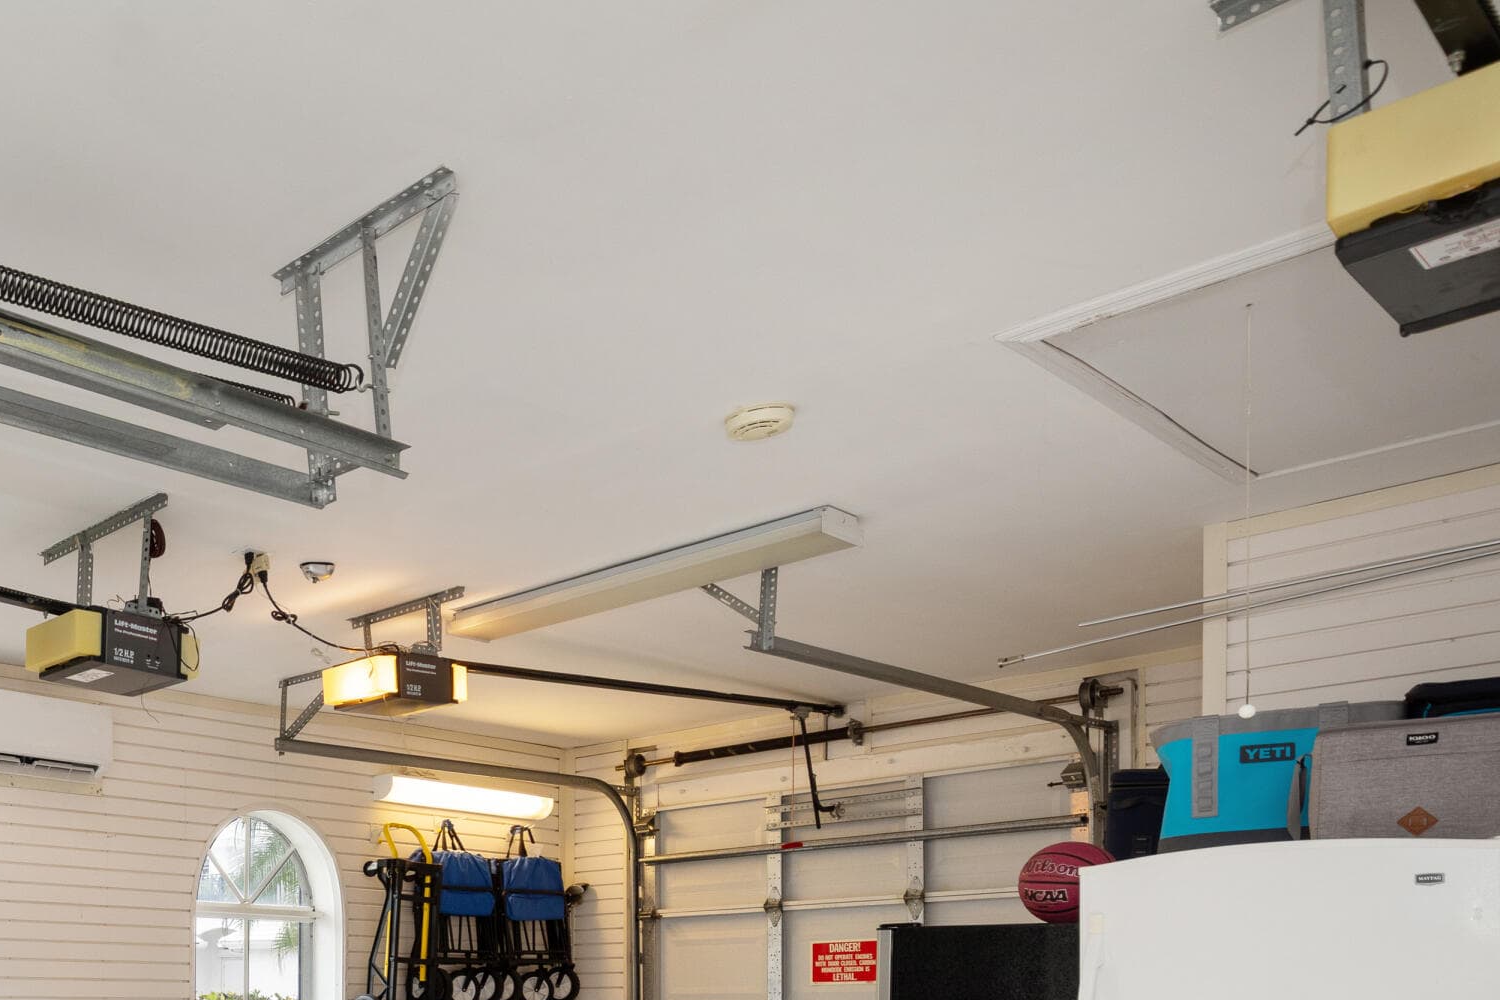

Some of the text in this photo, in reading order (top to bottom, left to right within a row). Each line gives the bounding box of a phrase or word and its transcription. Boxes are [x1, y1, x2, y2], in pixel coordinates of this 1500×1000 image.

[1244, 746, 1291, 760] YETI
[1023, 887, 1069, 903] NCAA
[829, 942, 861, 953] DANGER!
